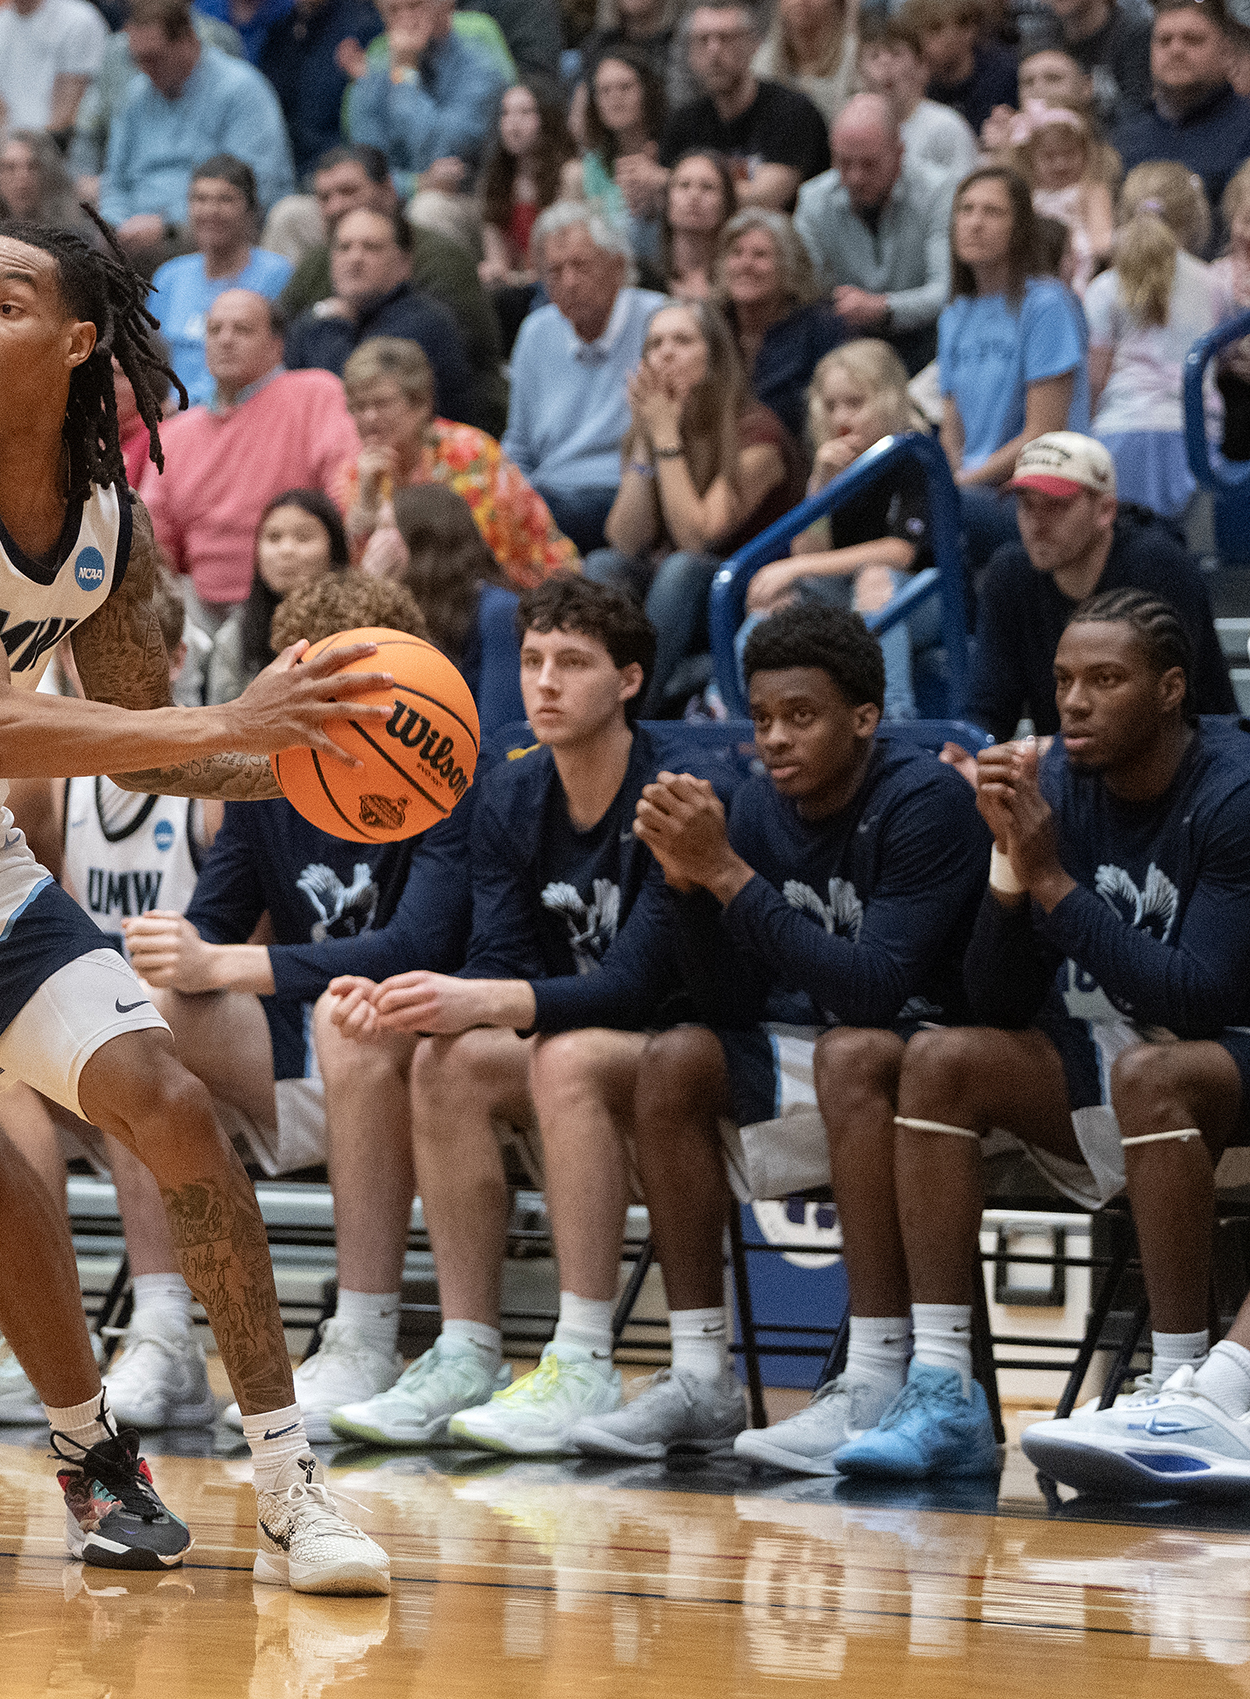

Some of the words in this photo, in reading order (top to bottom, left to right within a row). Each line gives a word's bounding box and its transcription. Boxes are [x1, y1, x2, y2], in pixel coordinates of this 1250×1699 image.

[78, 567, 103, 581] NCAA
[385, 699, 469, 802] Wilson
[88, 867, 164, 916] UMW
